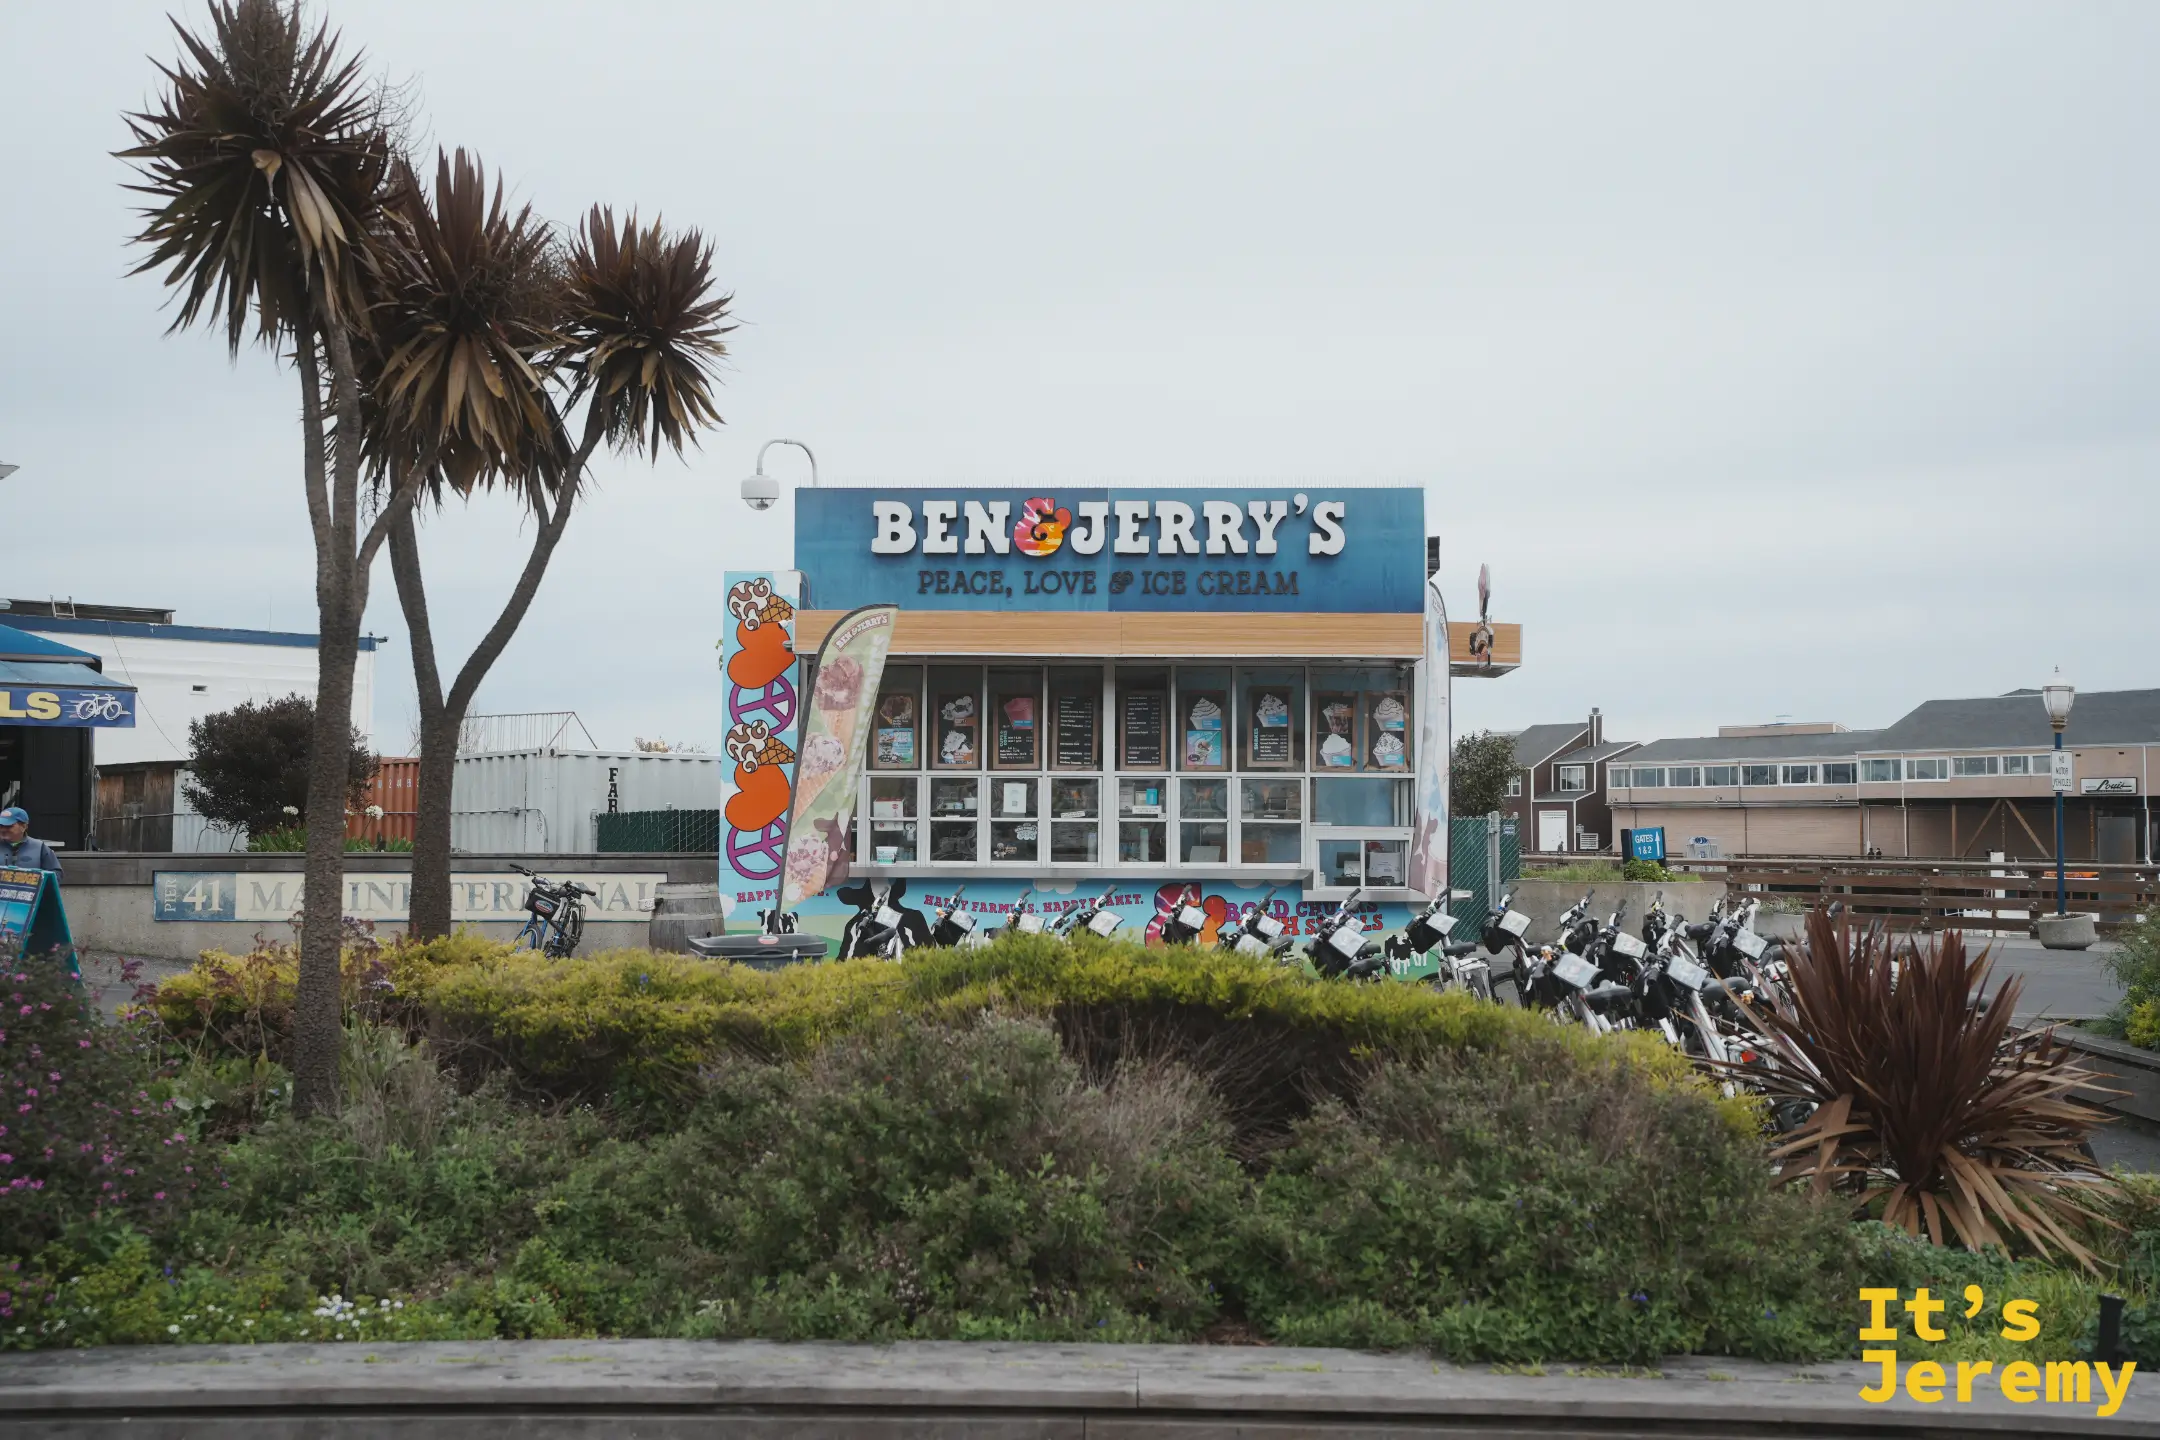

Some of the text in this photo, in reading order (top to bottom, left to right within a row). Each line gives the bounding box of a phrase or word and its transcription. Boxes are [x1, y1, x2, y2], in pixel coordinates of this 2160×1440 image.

[871, 493, 1346, 557] BEN & JERRY'S
[917, 570, 1300, 598] PEACE, LOVE & ICE CREAM
[836, 631, 853, 648] BEN
[857, 615, 888, 632] JERRY'S
[0, 691, 61, 720] LS
[607, 767, 619, 813] FAR
[1634, 834, 1654, 844] GATES
[164, 878, 177, 912] PIER
[182, 879, 224, 912] 41
[250, 881, 411, 912] MIN
[450, 881, 655, 912] ERNAL
[923, 894, 969, 911] HAPY
[971, 901, 1039, 914] FARMS.
[1089, 893, 1144, 910] PANET.
[1225, 899, 1378, 922] BOD CHUS
